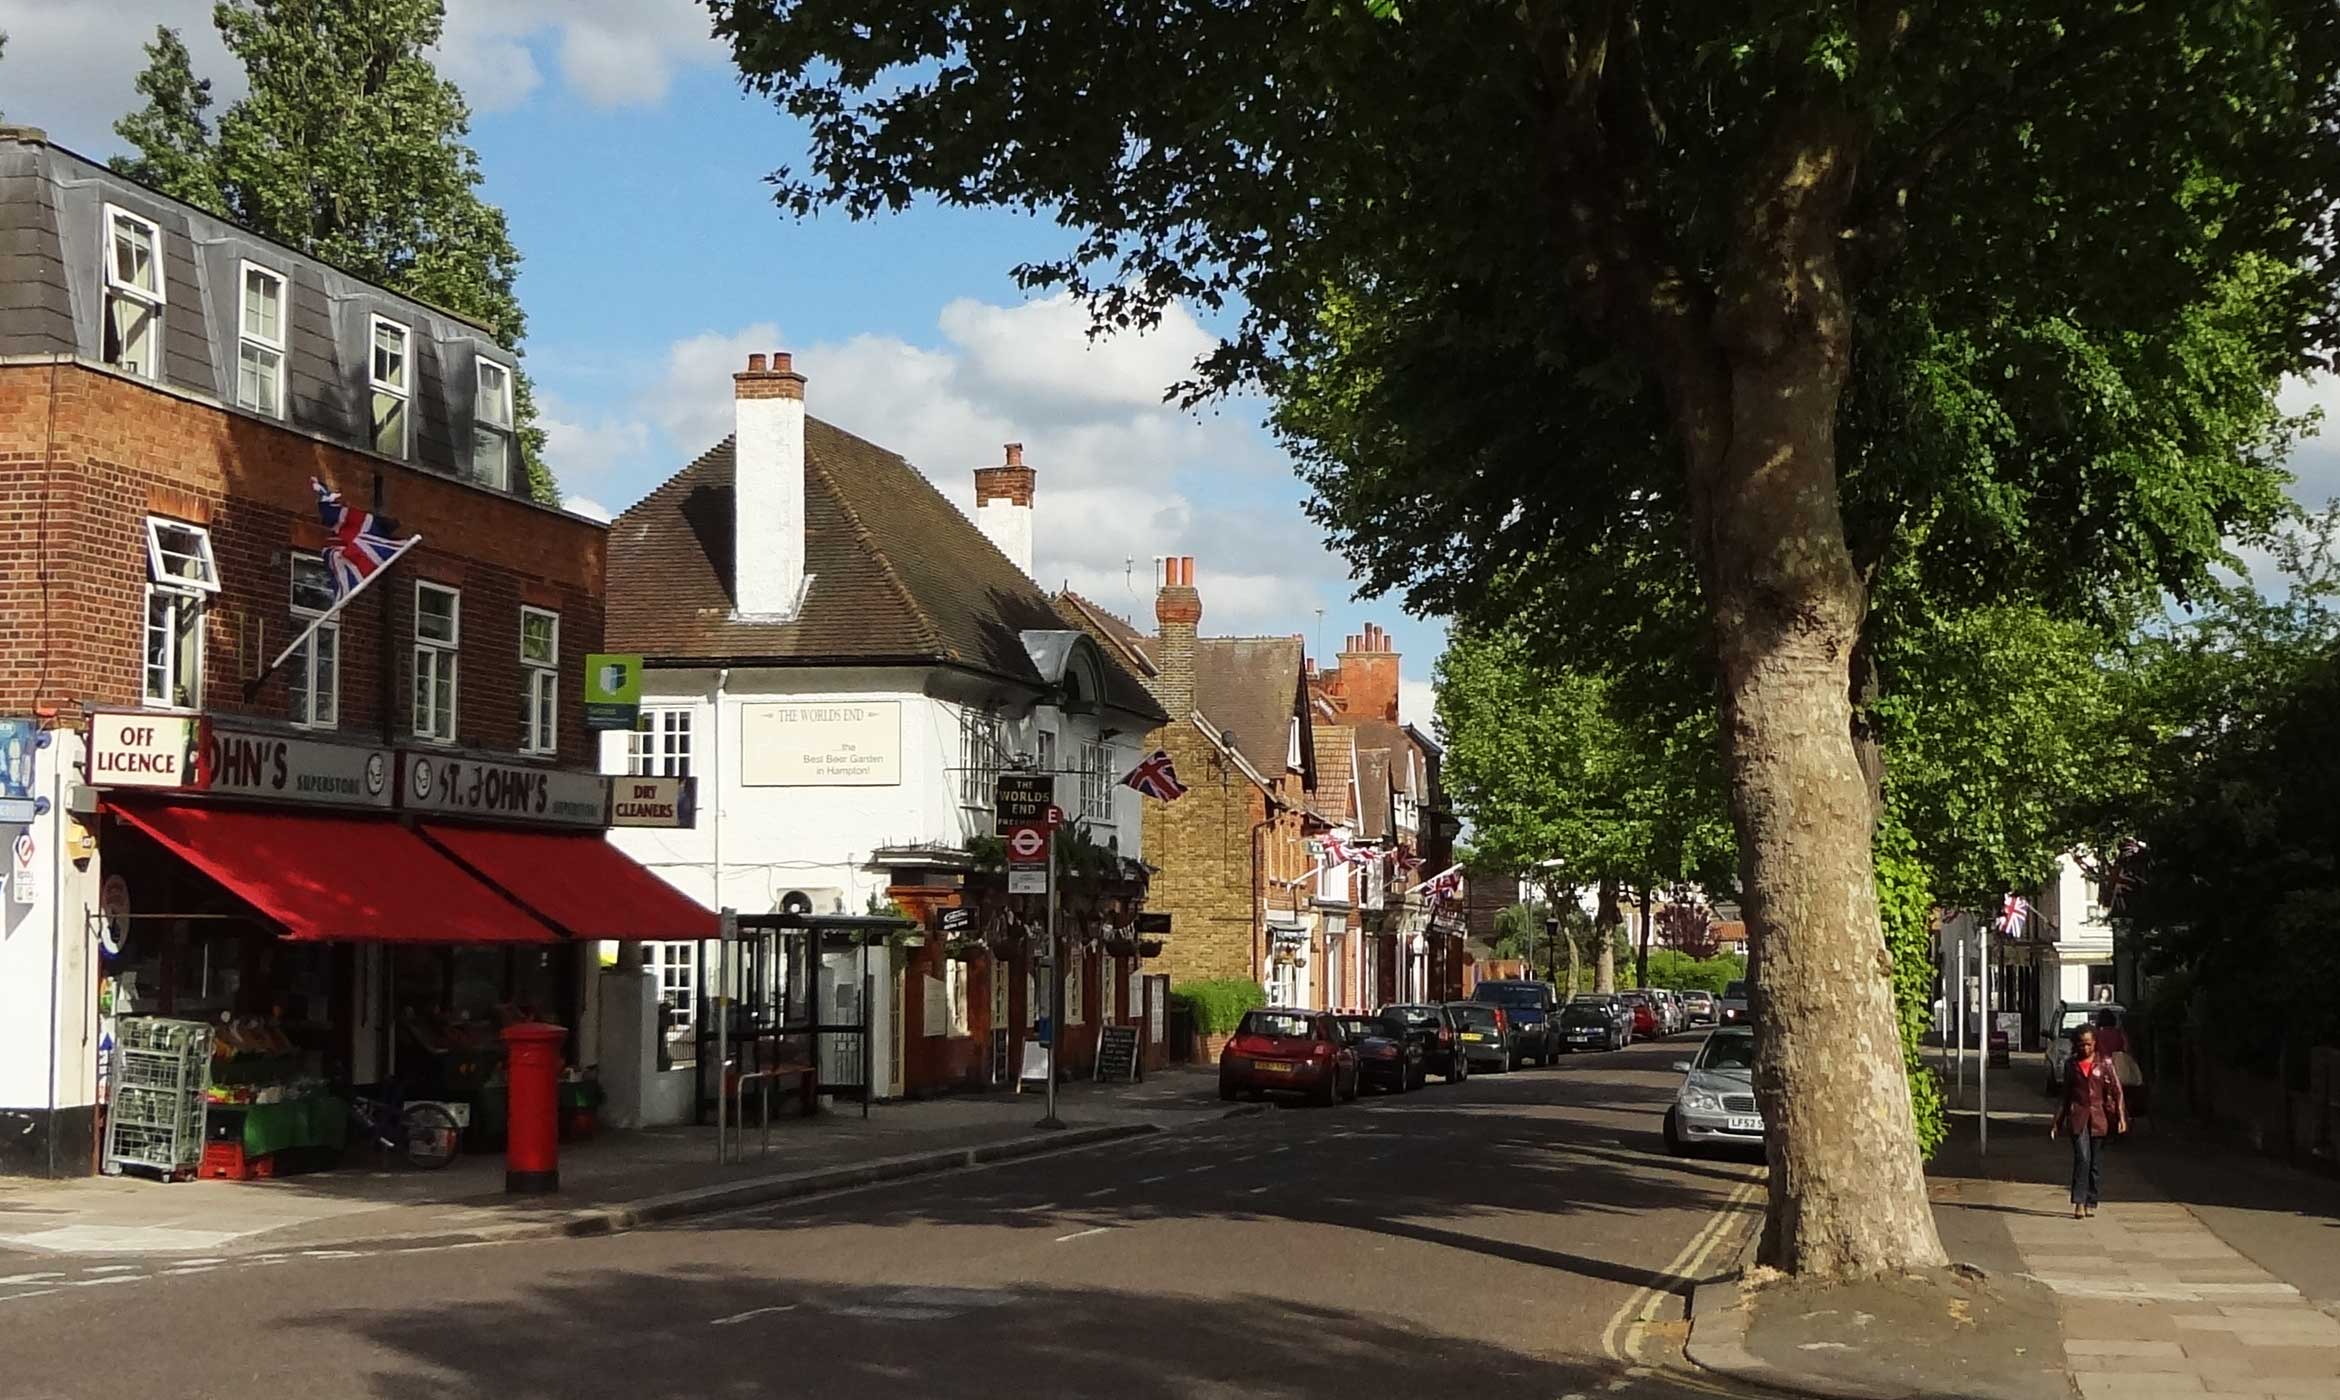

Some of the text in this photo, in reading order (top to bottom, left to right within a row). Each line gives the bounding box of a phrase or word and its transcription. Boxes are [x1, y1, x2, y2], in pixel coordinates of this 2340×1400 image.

[778, 708, 864, 722] THE WORLDS END
[120, 726, 155, 747] OFF
[97, 752, 175, 773] LICENCE
[803, 754, 884, 763] Best Beer Garden
[469, 766, 548, 813] JOHN'S
[633, 784, 658, 799] DRY
[1016, 781, 1033, 789] THE
[1000, 791, 1050, 802] WORLDS
[615, 804, 673, 818] CLEANERS
[1011, 804, 1036, 815] END
[1047, 809, 1058, 823] E
[1731, 1118, 1755, 1127] LF52
